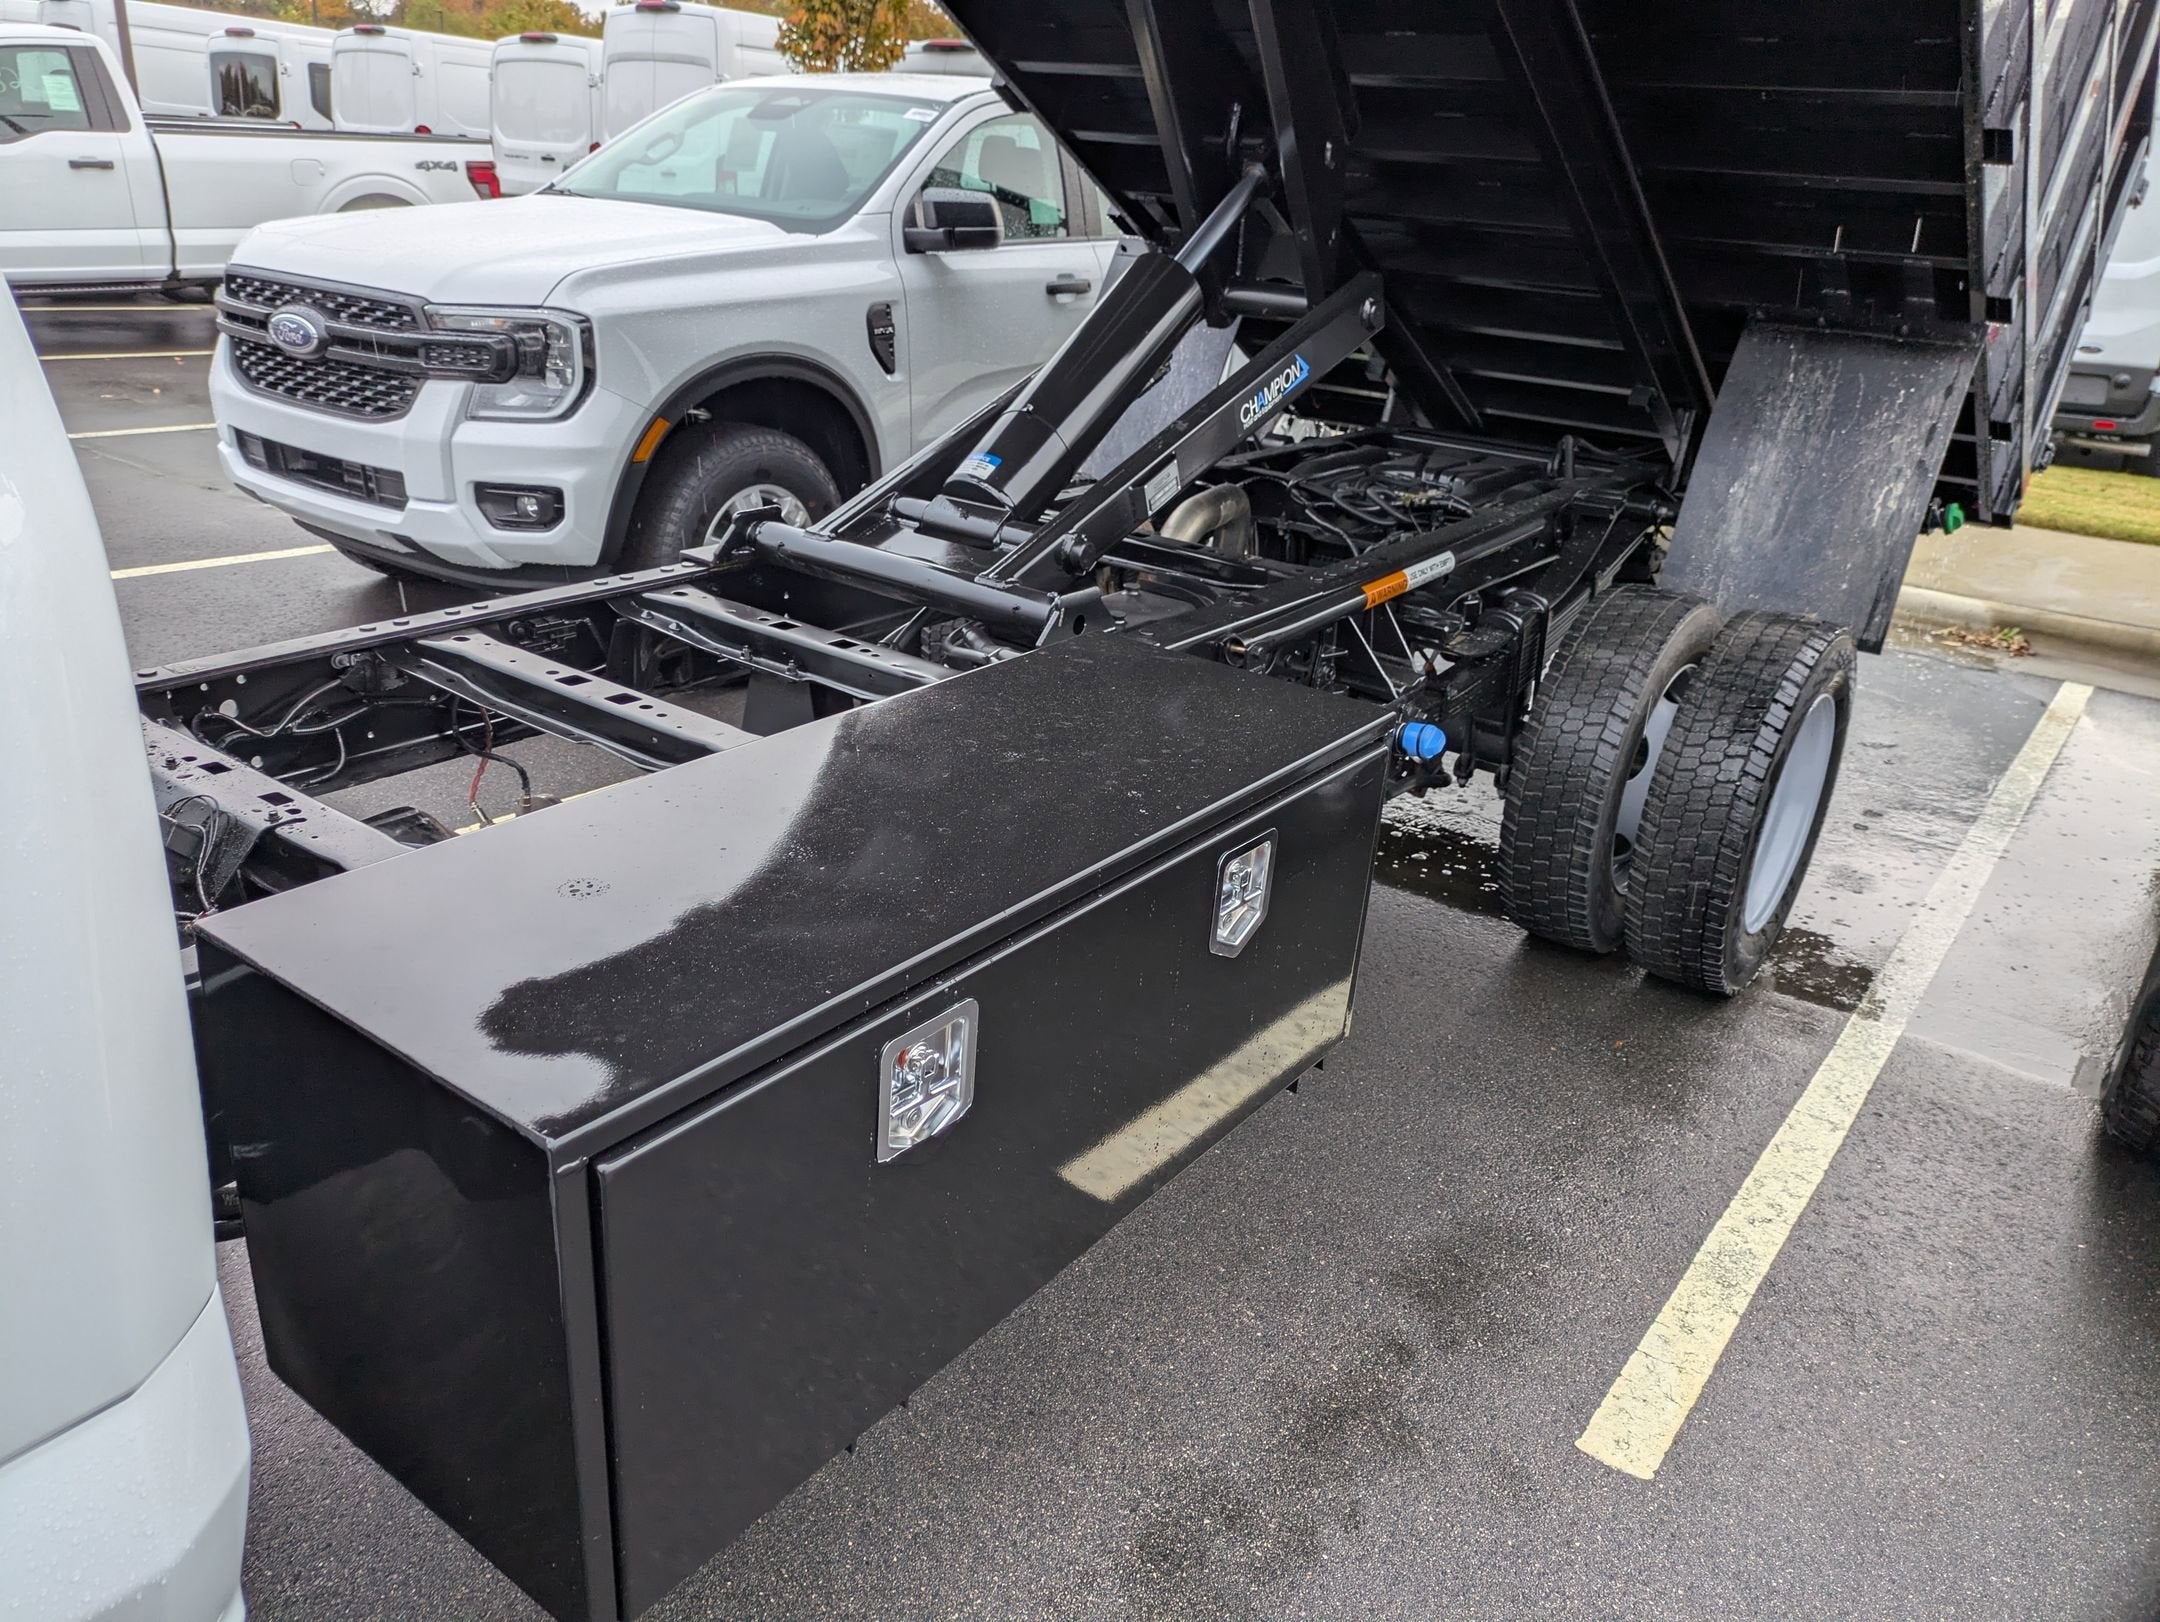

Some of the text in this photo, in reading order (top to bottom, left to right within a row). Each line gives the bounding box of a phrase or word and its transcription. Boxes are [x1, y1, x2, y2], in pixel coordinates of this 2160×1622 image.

[277, 320, 304, 345] Ford
[1239, 361, 1301, 423] CHAMPION
[1376, 579, 1408, 599] WARNING
